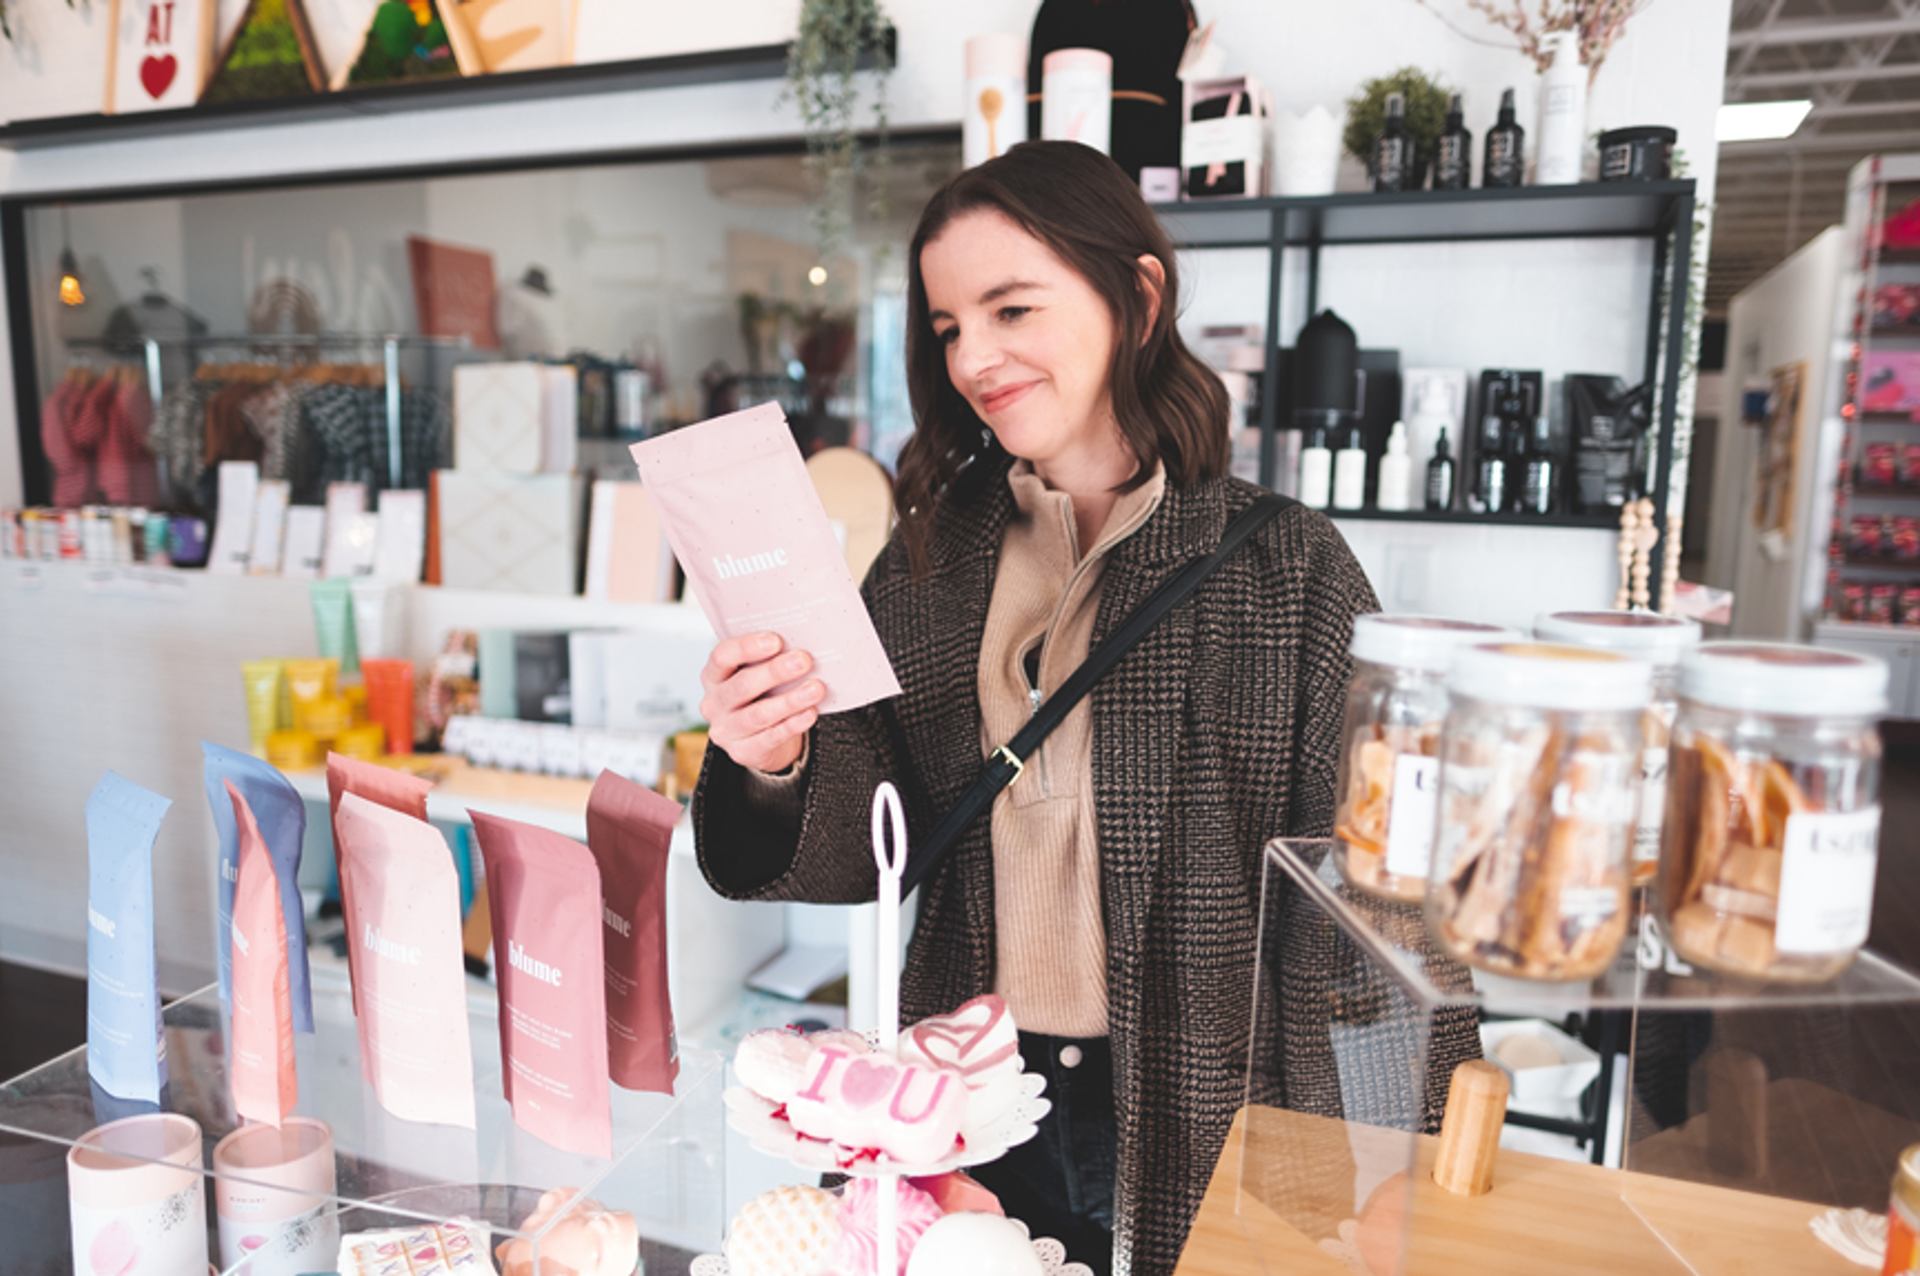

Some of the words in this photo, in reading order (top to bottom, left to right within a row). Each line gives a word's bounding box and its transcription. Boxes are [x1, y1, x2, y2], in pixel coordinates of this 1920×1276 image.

[712, 547, 788, 579] blume
[363, 921, 424, 966] blume
[507, 939, 562, 987] blume
